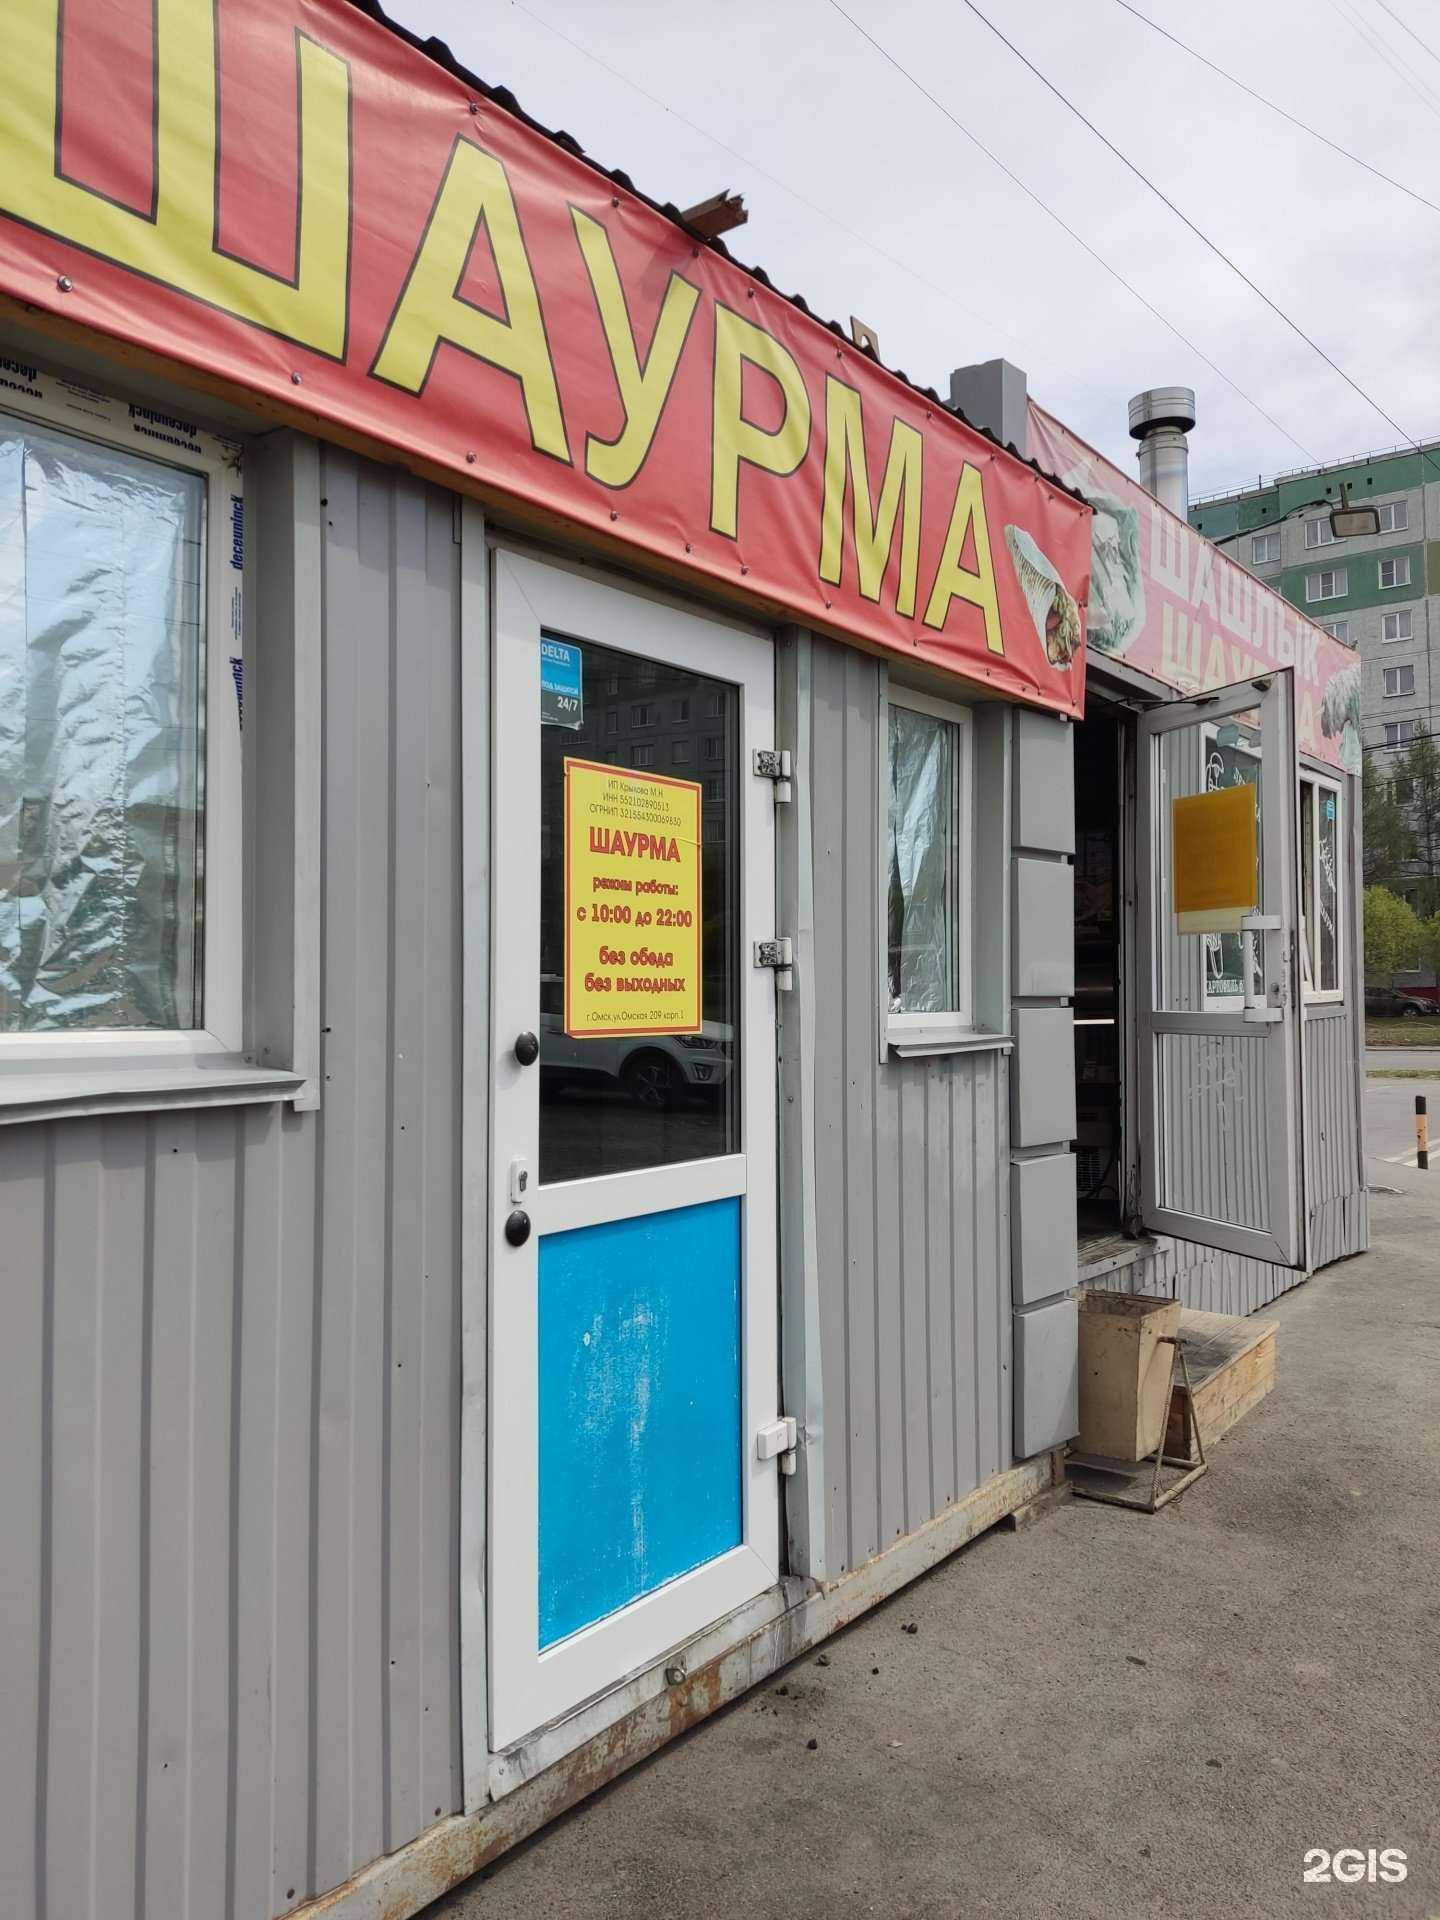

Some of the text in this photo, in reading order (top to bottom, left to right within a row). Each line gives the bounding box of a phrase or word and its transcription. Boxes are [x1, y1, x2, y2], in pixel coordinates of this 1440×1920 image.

[0, 0, 1005, 656] ШАУРМА
[229, 495, 245, 571] deceuninck
[1150, 505, 1321, 688] ШАШЛЫК
[541, 643, 570, 662] DELTA
[557, 696, 579, 712] 24/7
[608, 778, 619, 790] ИП
[602, 792, 618, 801] ИНН
[589, 803, 618, 816] ОГРНИП
[589, 826, 681, 863] ШАУРМА
[636, 879, 679, 896] работы:
[592, 904, 632, 924] 10:00
[635, 911, 652, 927] до
[656, 908, 693, 928] 22:00
[599, 945, 673, 968] без обеда
[584, 972, 686, 994] без выходных
